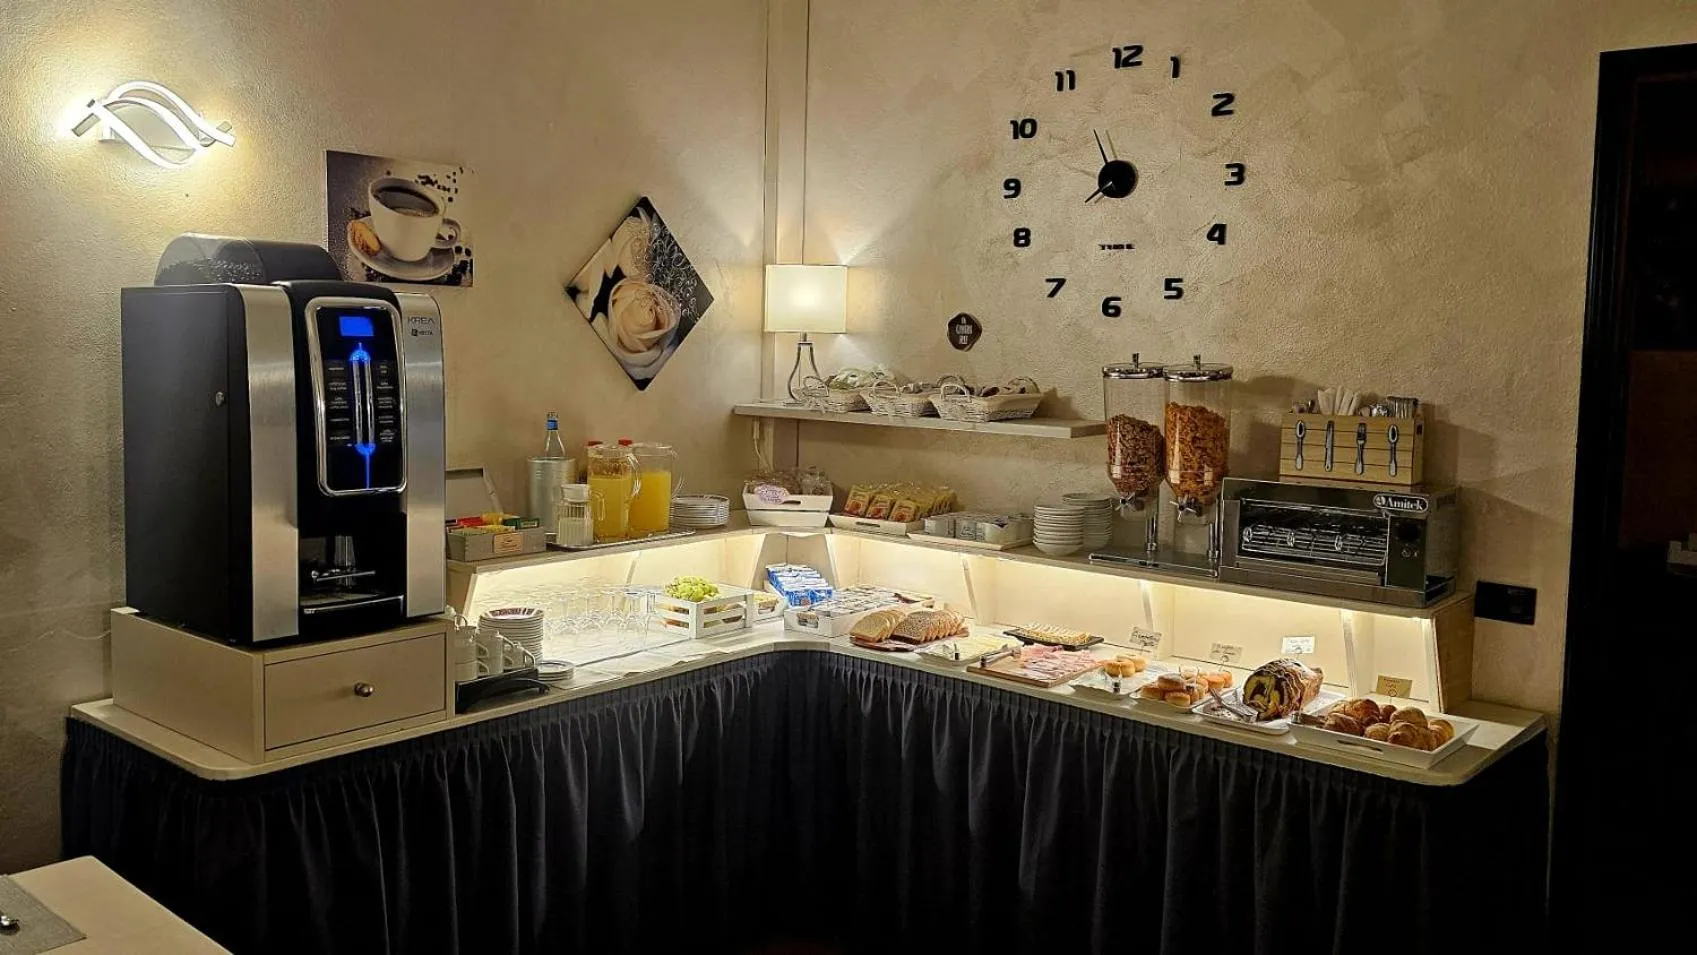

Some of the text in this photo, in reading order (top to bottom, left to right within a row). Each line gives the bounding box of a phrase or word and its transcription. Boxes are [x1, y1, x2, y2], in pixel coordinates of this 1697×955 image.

[1112, 44, 1144, 69] 12
[1170, 56, 1181, 79] 1
[1054, 69, 1076, 92] 11
[1211, 92, 1236, 117] 2
[1009, 118, 1038, 140] 10
[1224, 162, 1246, 187] 3
[1003, 178, 1022, 200] 9
[1013, 227, 1031, 248] 8
[1206, 223, 1227, 246] 4
[1045, 277, 1067, 299] 7
[1163, 277, 1184, 300] 5
[1101, 296, 1122, 318] 6
